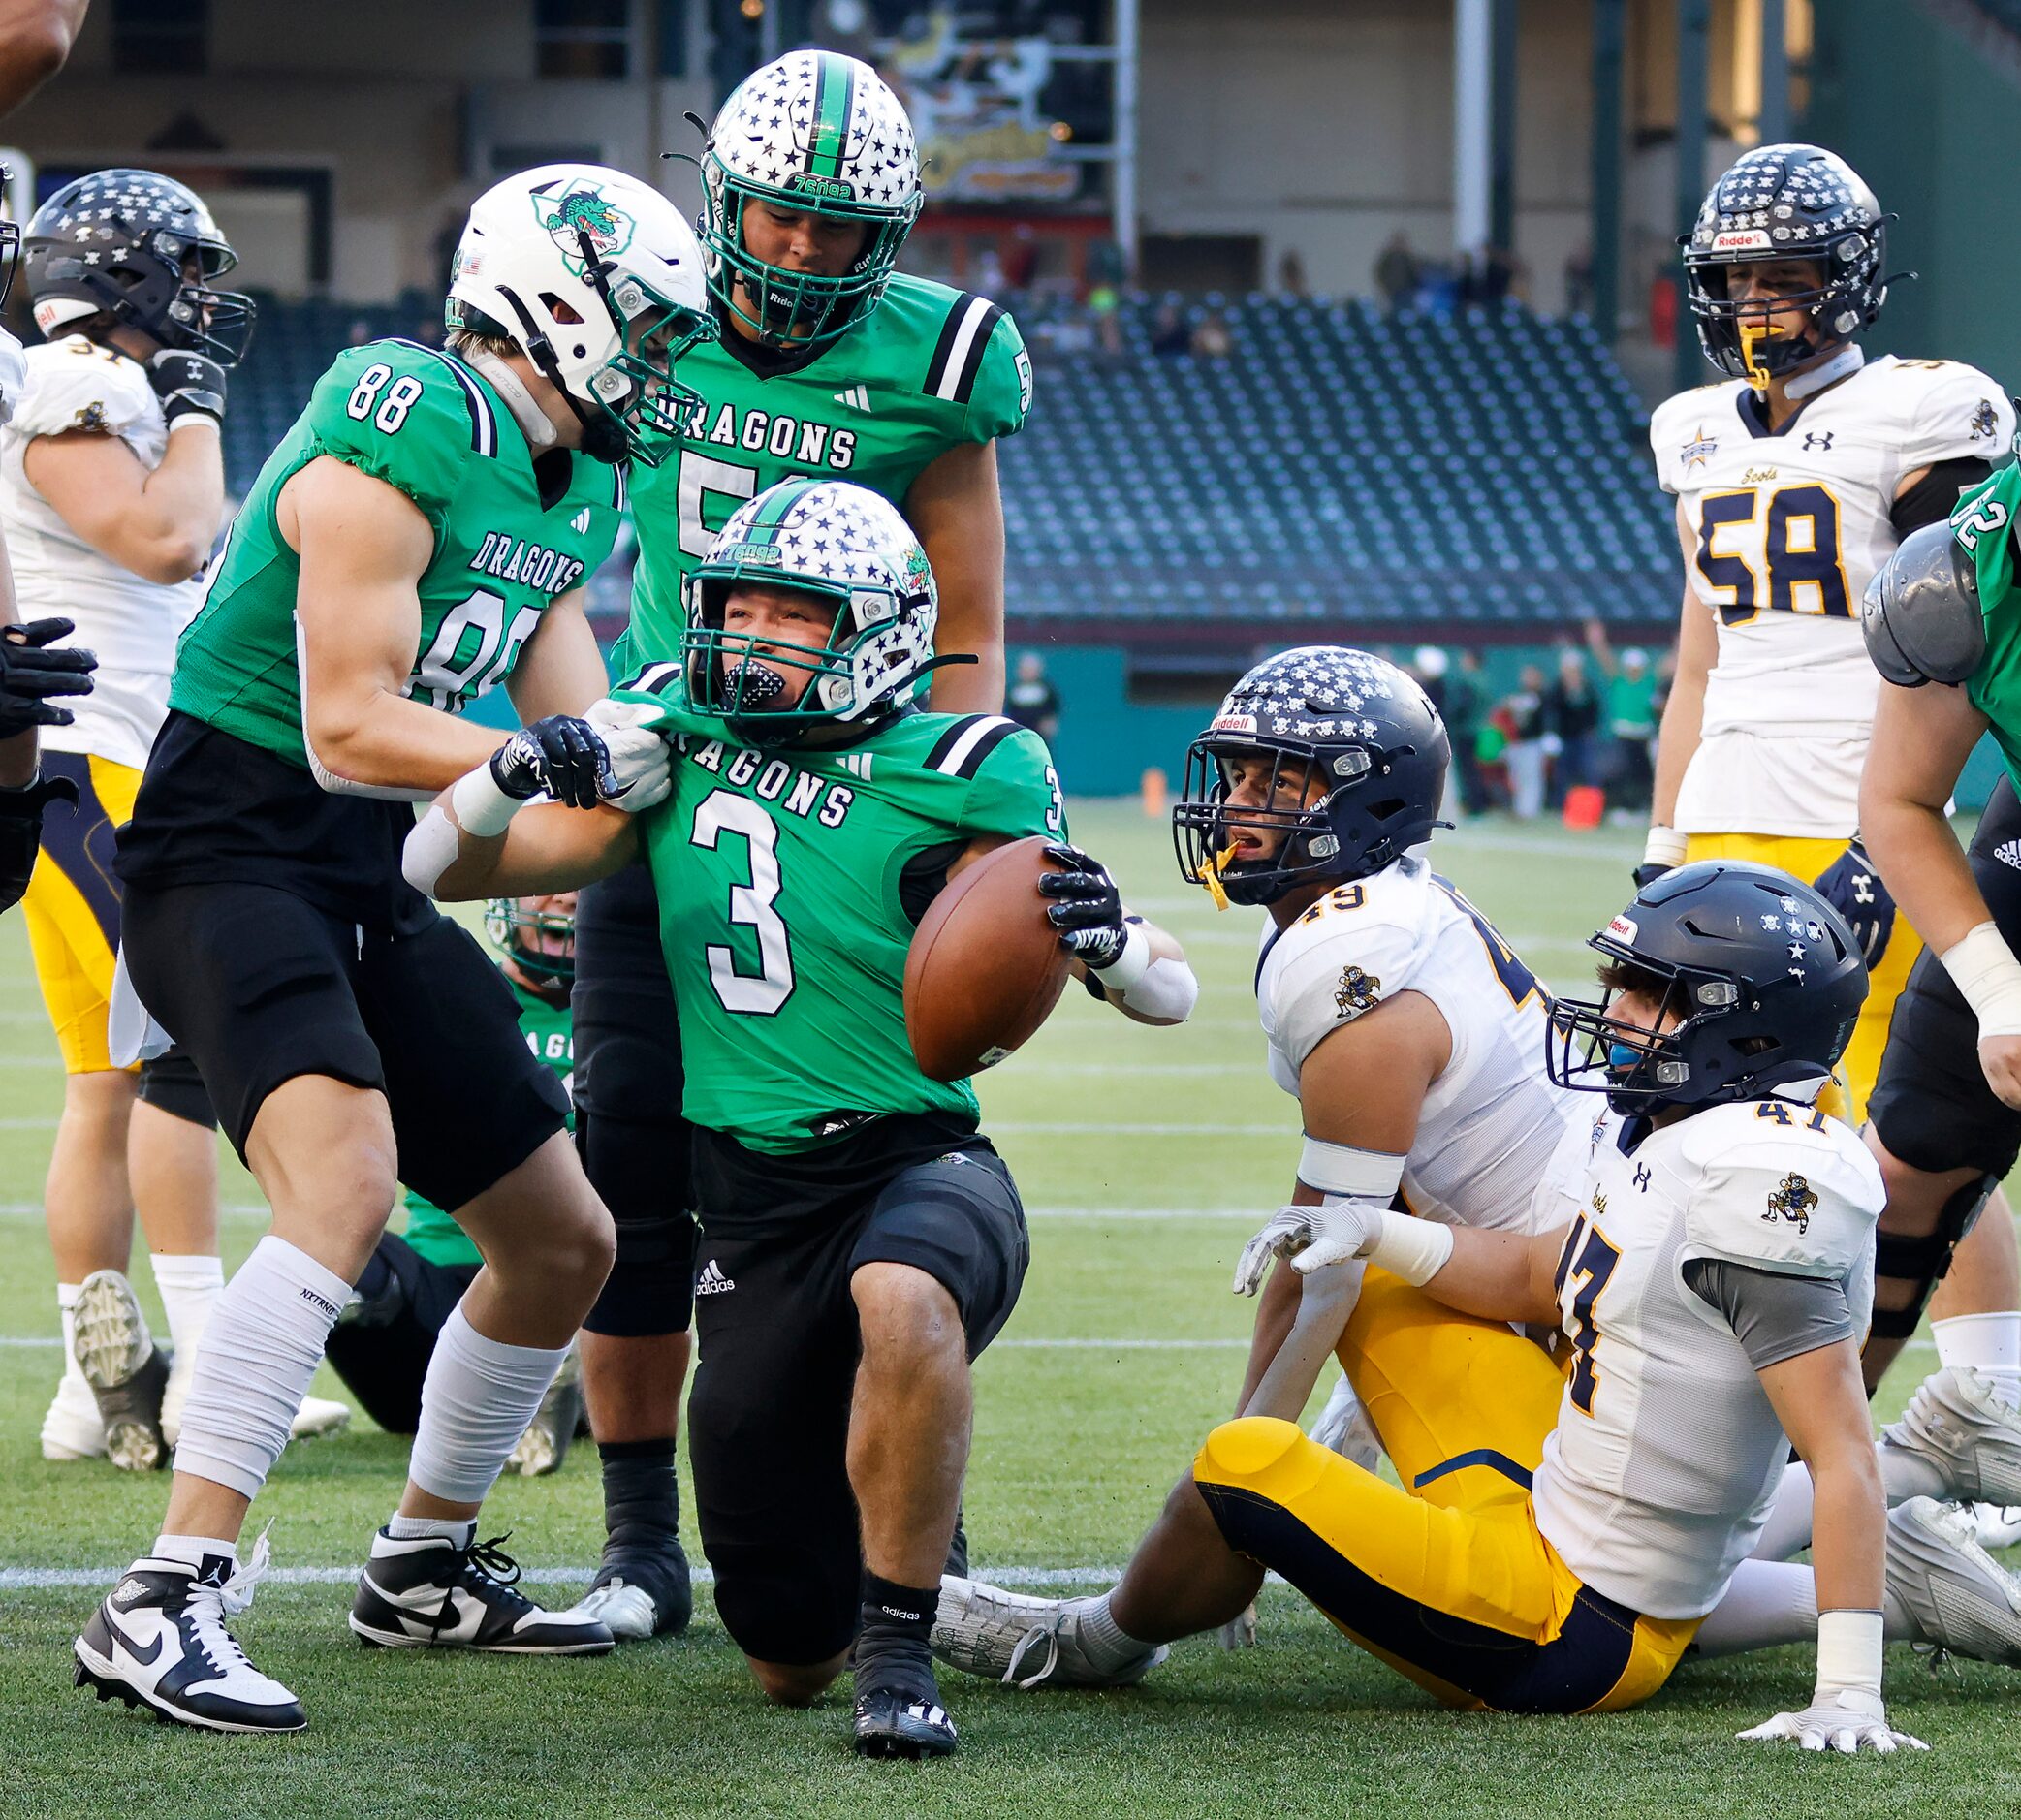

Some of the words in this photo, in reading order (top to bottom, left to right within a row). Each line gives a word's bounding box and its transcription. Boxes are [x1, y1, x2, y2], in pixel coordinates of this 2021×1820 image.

[794, 176, 852, 201] 76092
[346, 362, 424, 436] 88
[1012, 345, 1033, 415] 5
[654, 390, 858, 471] DRAGONS
[1740, 466, 1779, 485] Scots
[467, 529, 585, 594] DRAGONS
[725, 543, 781, 563] 76092
[1696, 481, 1856, 628] 58
[1044, 764, 1064, 832] 3
[688, 785, 797, 1018] 3
[300, 1288, 336, 1316] NXTRND
[696, 1279, 736, 1296] adidas
[881, 1605, 921, 1621] adidas
